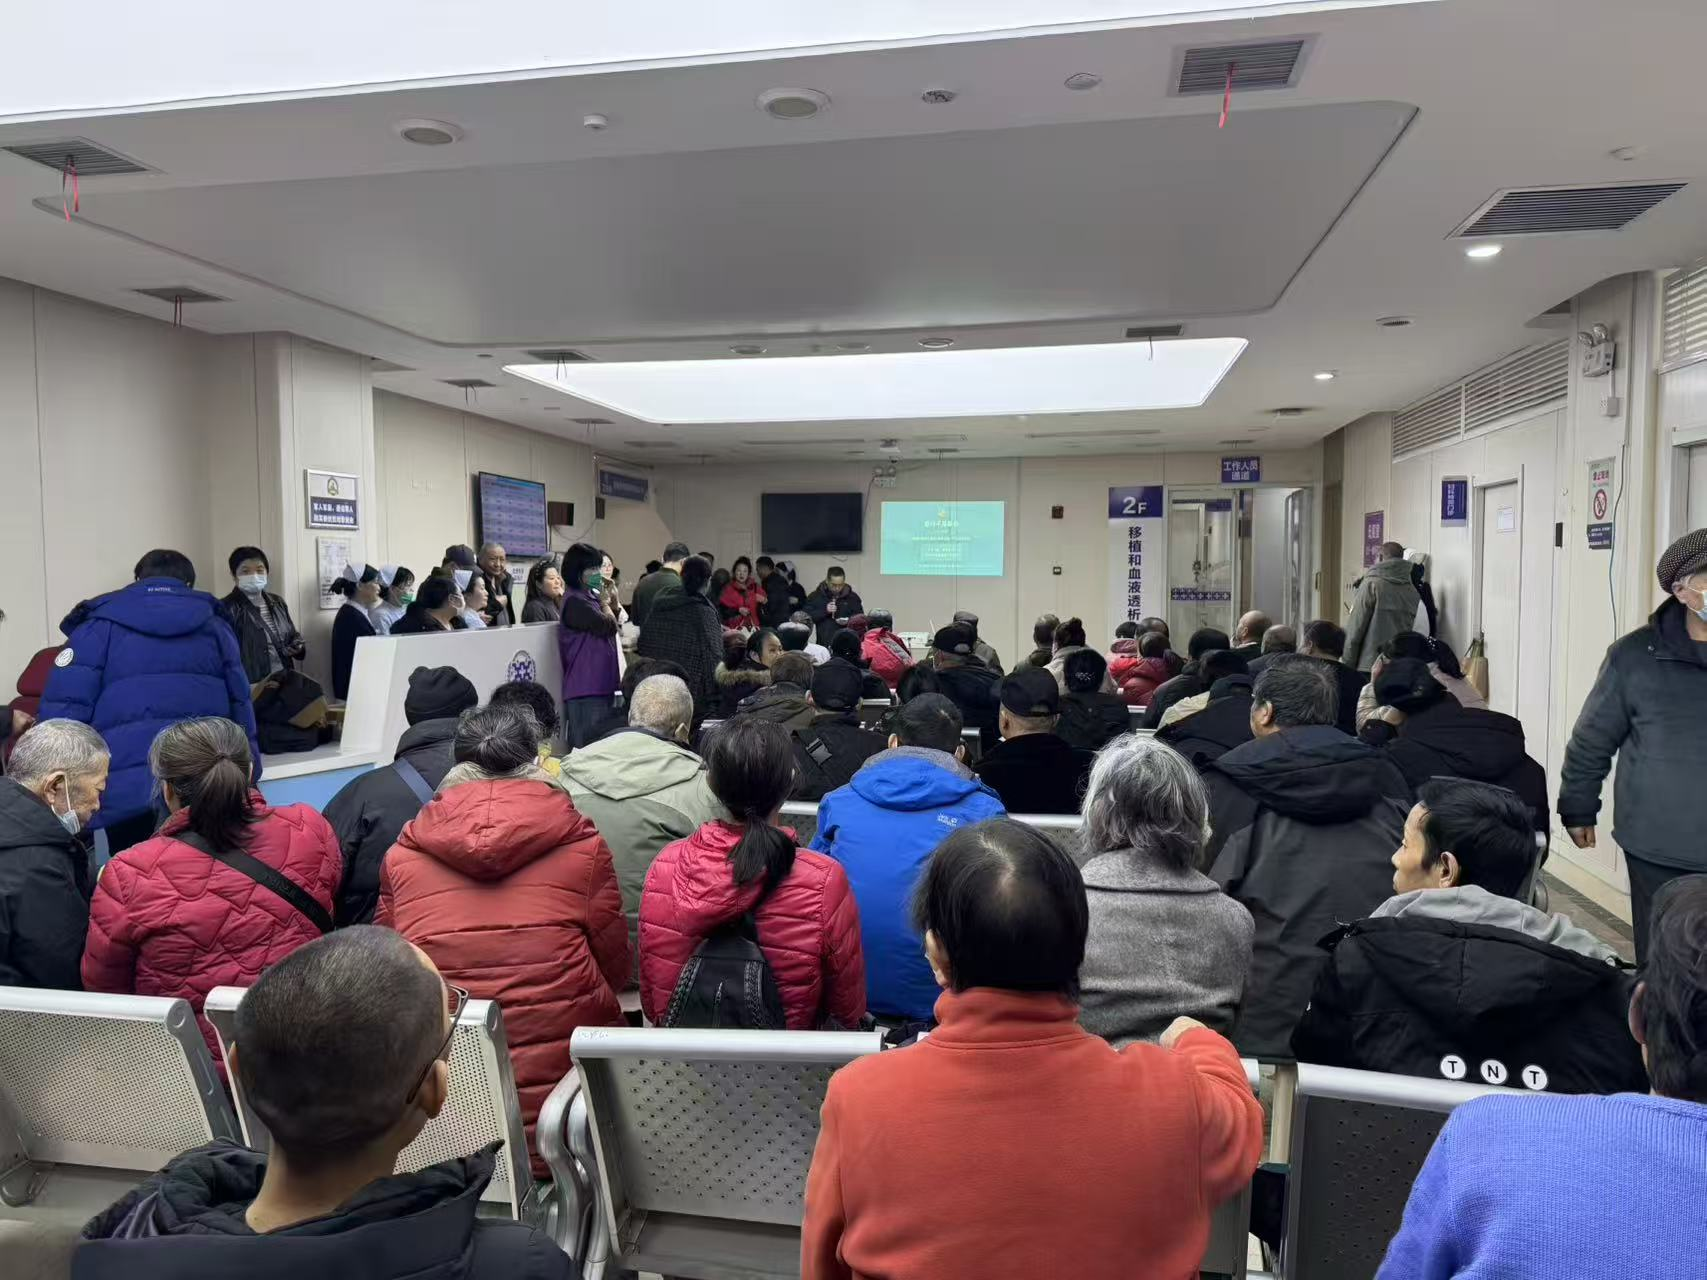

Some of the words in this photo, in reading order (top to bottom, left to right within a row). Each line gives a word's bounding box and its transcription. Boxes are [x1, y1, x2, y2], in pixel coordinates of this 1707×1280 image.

[1224, 461, 1258, 471] 工作人员
[1232, 472, 1250, 481] 通道
[1122, 496, 1147, 515] 2F
[1128, 526, 1142, 621] 移植和血液透析
